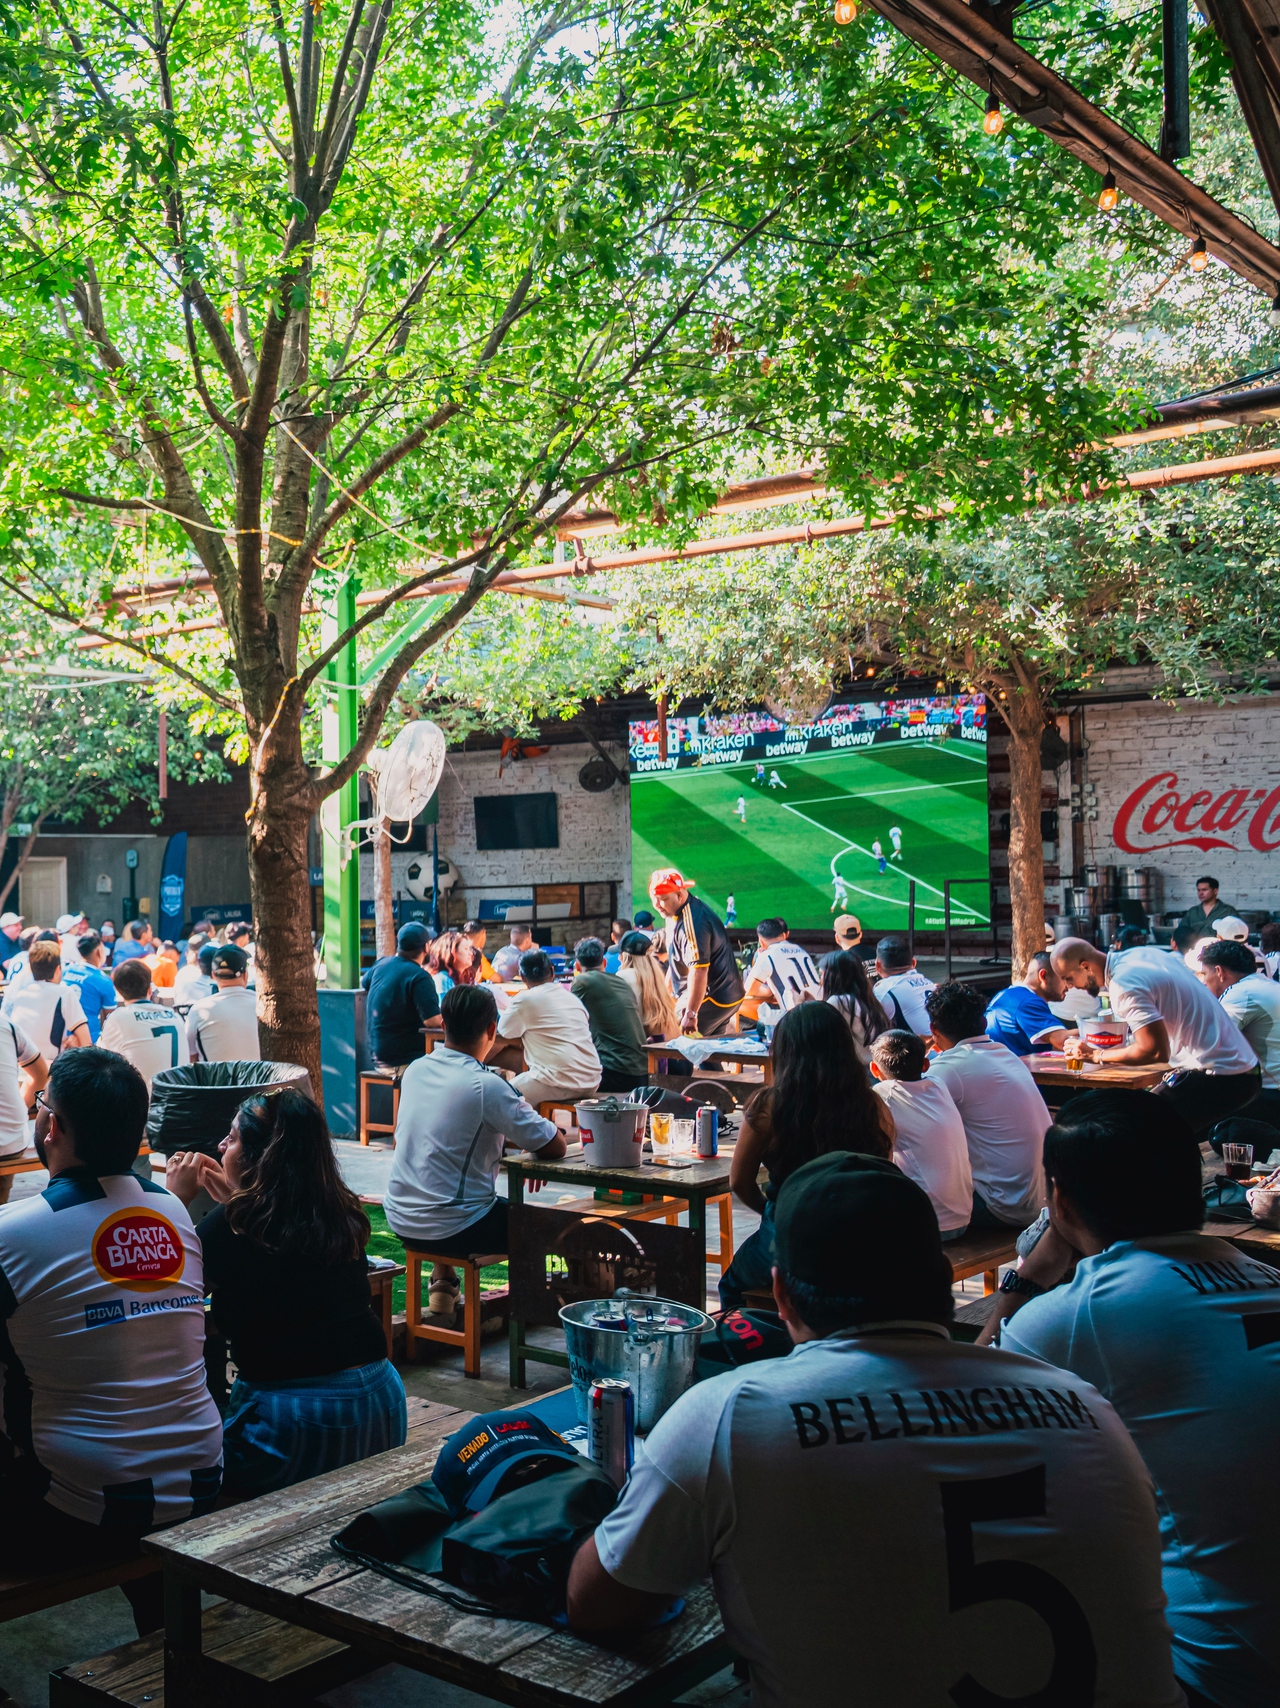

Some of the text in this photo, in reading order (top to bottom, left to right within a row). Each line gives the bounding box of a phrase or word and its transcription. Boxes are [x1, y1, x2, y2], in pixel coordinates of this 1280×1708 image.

[799, 721, 853, 740] kraken
[831, 731, 876, 748] betway
[900, 722, 948, 739] betway
[961, 725, 987, 742] betwa
[702, 732, 755, 750] kraken
[766, 741, 809, 757] betway
[636, 757, 679, 772] betway
[701, 749, 744, 765] betway
[1112, 772, 1280, 854] Coca-C
[151, 1025, 179, 1068] 7
[112, 1226, 171, 1246] CARTA
[106, 1243, 179, 1268] BLANCA
[1169, 1260, 1257, 1295] VINI
[87, 1305, 124, 1321] BBVA
[788, 1388, 1101, 1450] BELLINGHAM
[457, 1431, 490, 1464] VENADO
[939, 1463, 1099, 1708] 5
